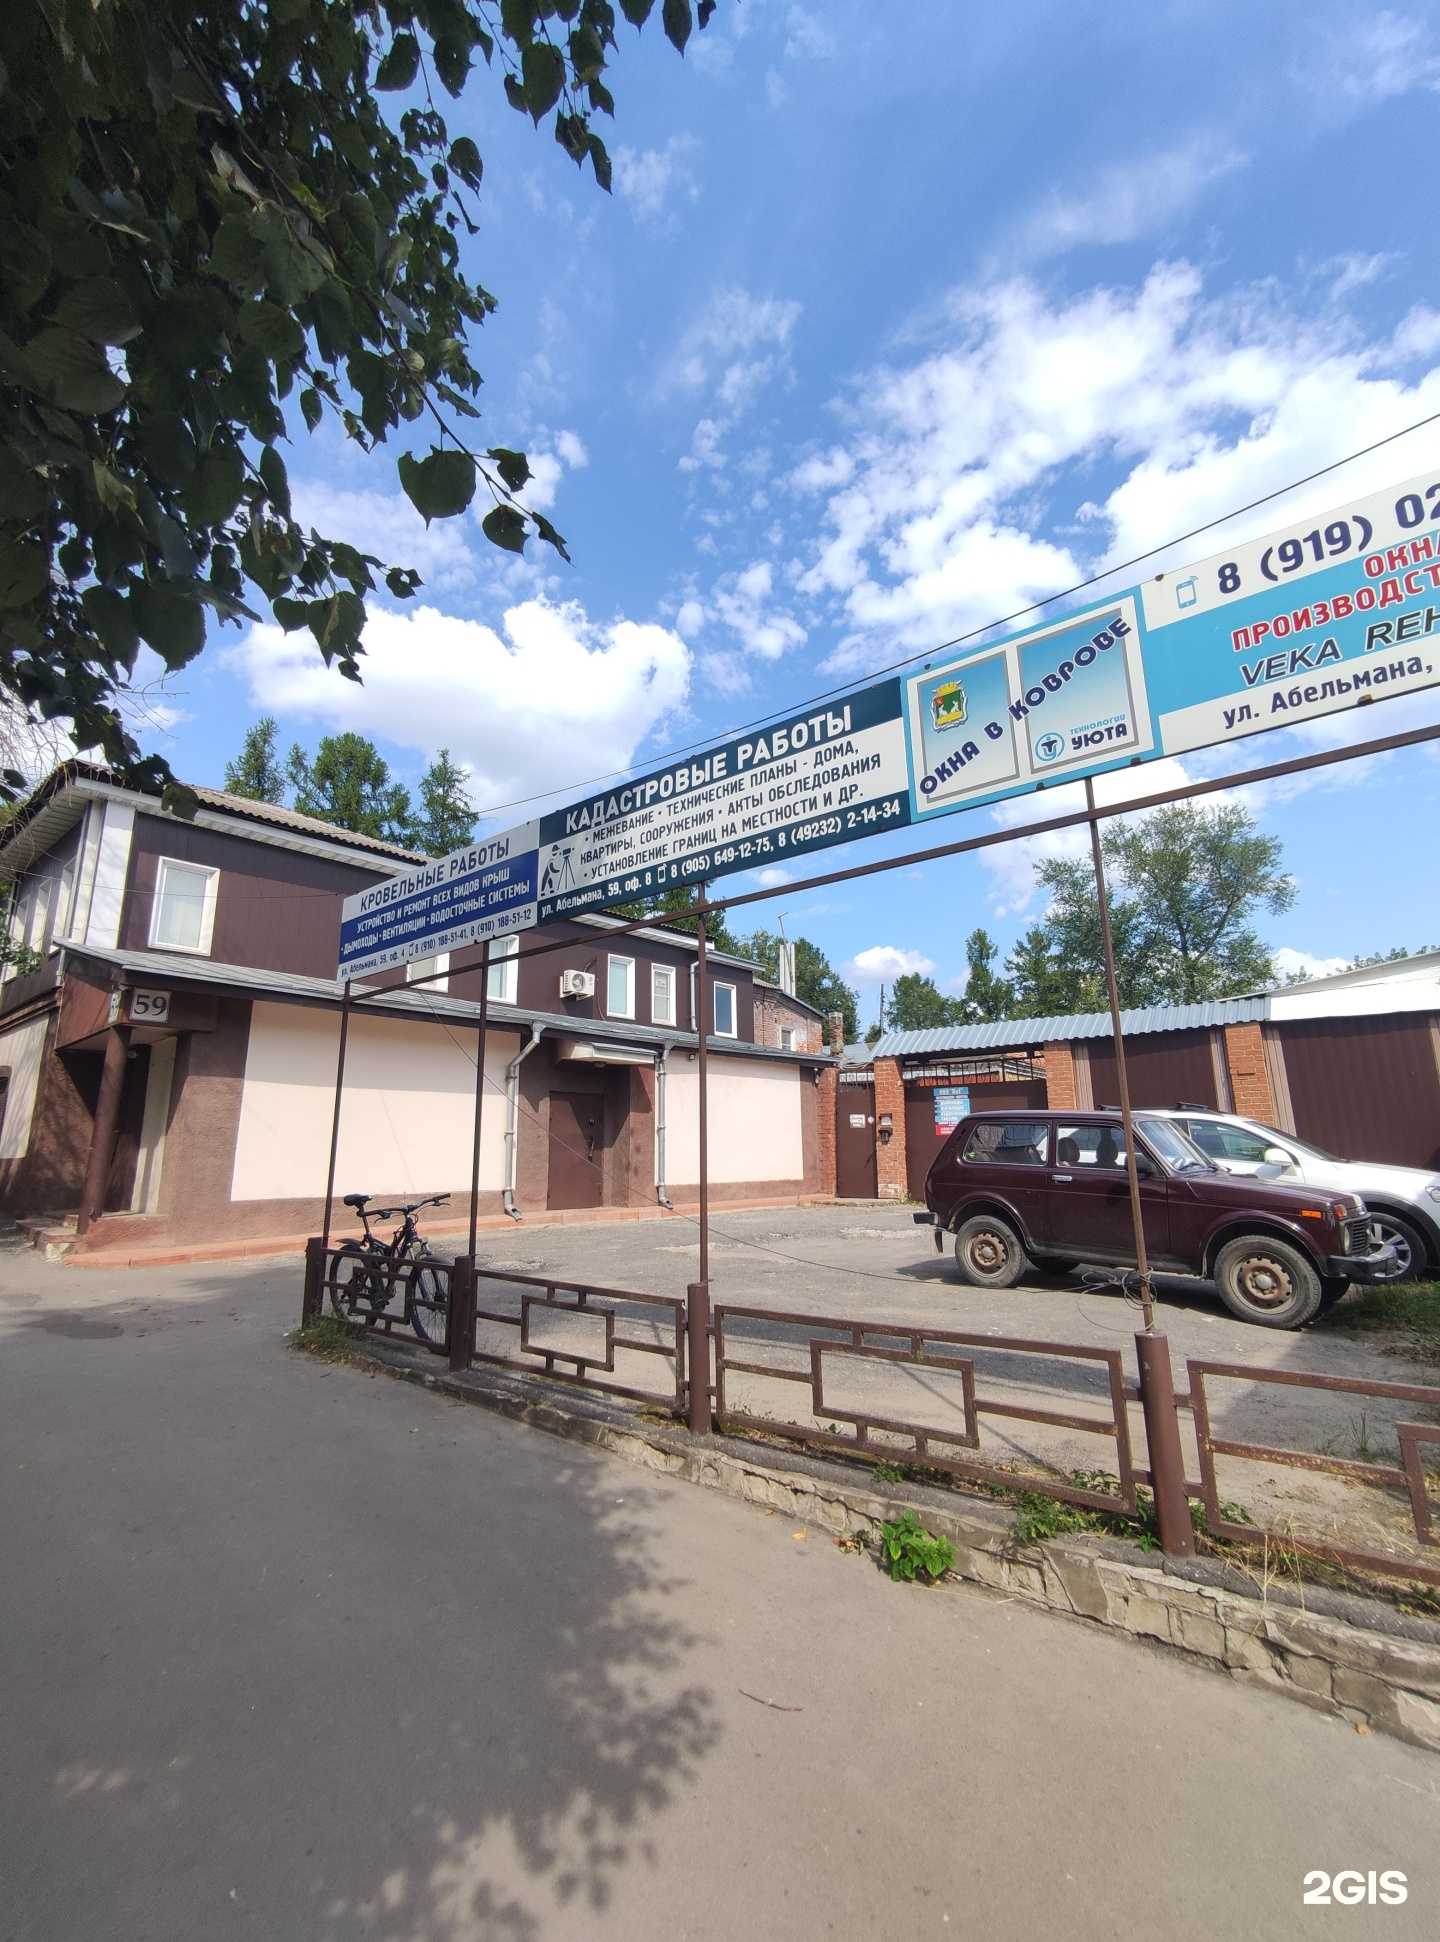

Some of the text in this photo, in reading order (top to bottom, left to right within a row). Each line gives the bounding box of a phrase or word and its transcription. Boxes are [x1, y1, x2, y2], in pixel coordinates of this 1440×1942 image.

[1217, 562, 1241, 594] 8
[1260, 515, 1373, 582] (919)
[1223, 656, 1433, 729] ул. Абельмана,
[1240, 638, 1341, 686] VEKA
[919, 617, 1132, 795] ОКНА В КОВРОВЕ
[1071, 723, 1128, 750] УЮТА
[565, 705, 850, 834] КАДАСТРОВЫЕ РАБОТЫ
[592, 811, 655, 842] МЕЖЕВАНИЕ
[666, 778, 745, 816] ТЕХНИЧЕСКИЕ
[750, 760, 797, 787] ПЛАНЫ
[814, 740, 859, 768] ДОМА,
[580, 753, 881, 864] КВАРТИРЫ, СООРУЖЕНИЯ АКТЫ ОБСЛЕДОВАНИЯ
[591, 783, 863, 879] УСТАНОВЛЕНИЕ ГРАНИЦ НА МЕСТНОСТИ И ДР.
[360, 838, 509, 912] КРОВЕЛЬНЫЕ РАБОТЫ
[541, 799, 900, 918] ул. Абельмана, 59, оф. 8 8 (905) 649-12-75, 8 (49232) 2-14-34
[357, 910, 395, 933] УСТРОЙСТВО
[404, 897, 431, 917] РЕМОНТ
[433, 888, 451, 906] ВСЕХ
[453, 879, 480, 898] ВИДОВ
[482, 867, 510, 888] КРЫШ
[382, 915, 426, 940] ВЕНТИЛЯЦИИ
[430, 895, 485, 925] ВОДОСТОЧНЫЕ
[488, 880, 529, 905] СИСТЕМЫ
[498, 908, 532, 928] 188-51-12
[134, 994, 167, 1016] 59
